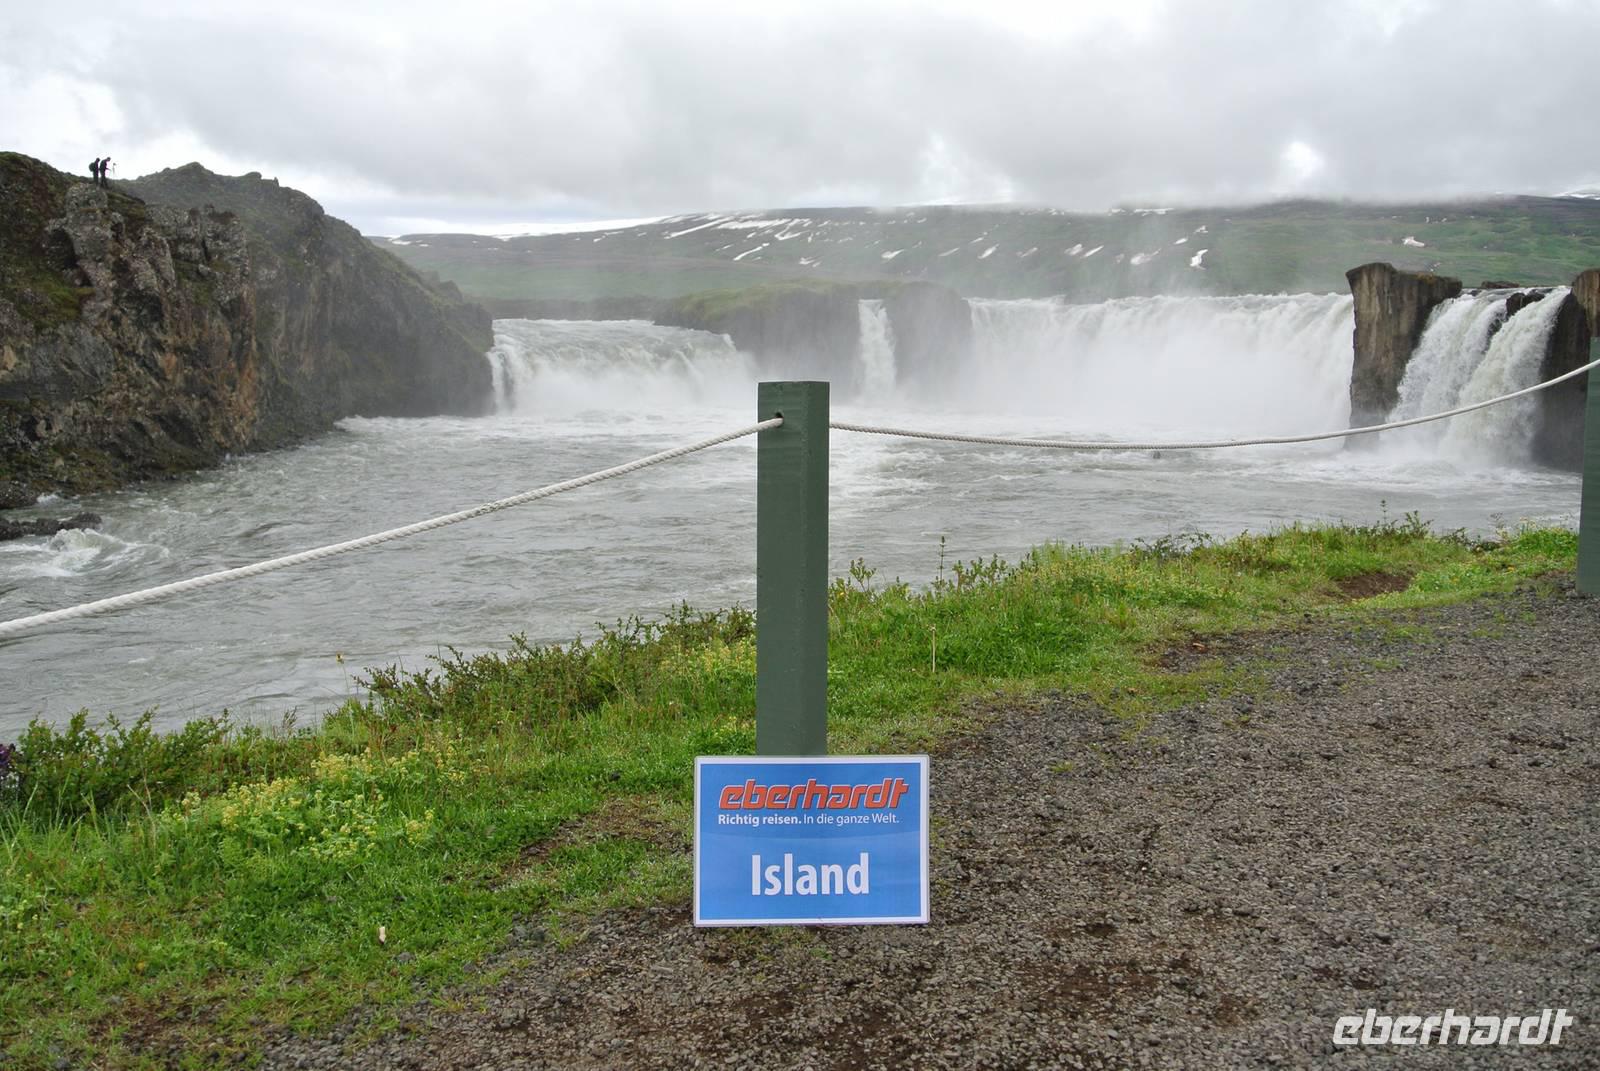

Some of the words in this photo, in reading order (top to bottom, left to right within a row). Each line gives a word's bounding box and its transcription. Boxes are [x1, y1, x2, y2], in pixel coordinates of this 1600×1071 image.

[718, 778, 910, 810] eberhardt
[718, 813, 760, 827] Richtig
[762, 814, 802, 825] reisen.
[803, 814, 814, 824] In
[816, 813, 834, 824] die
[836, 815, 870, 827] ganze
[871, 812, 900, 824] Welt.
[751, 852, 870, 896] Island
